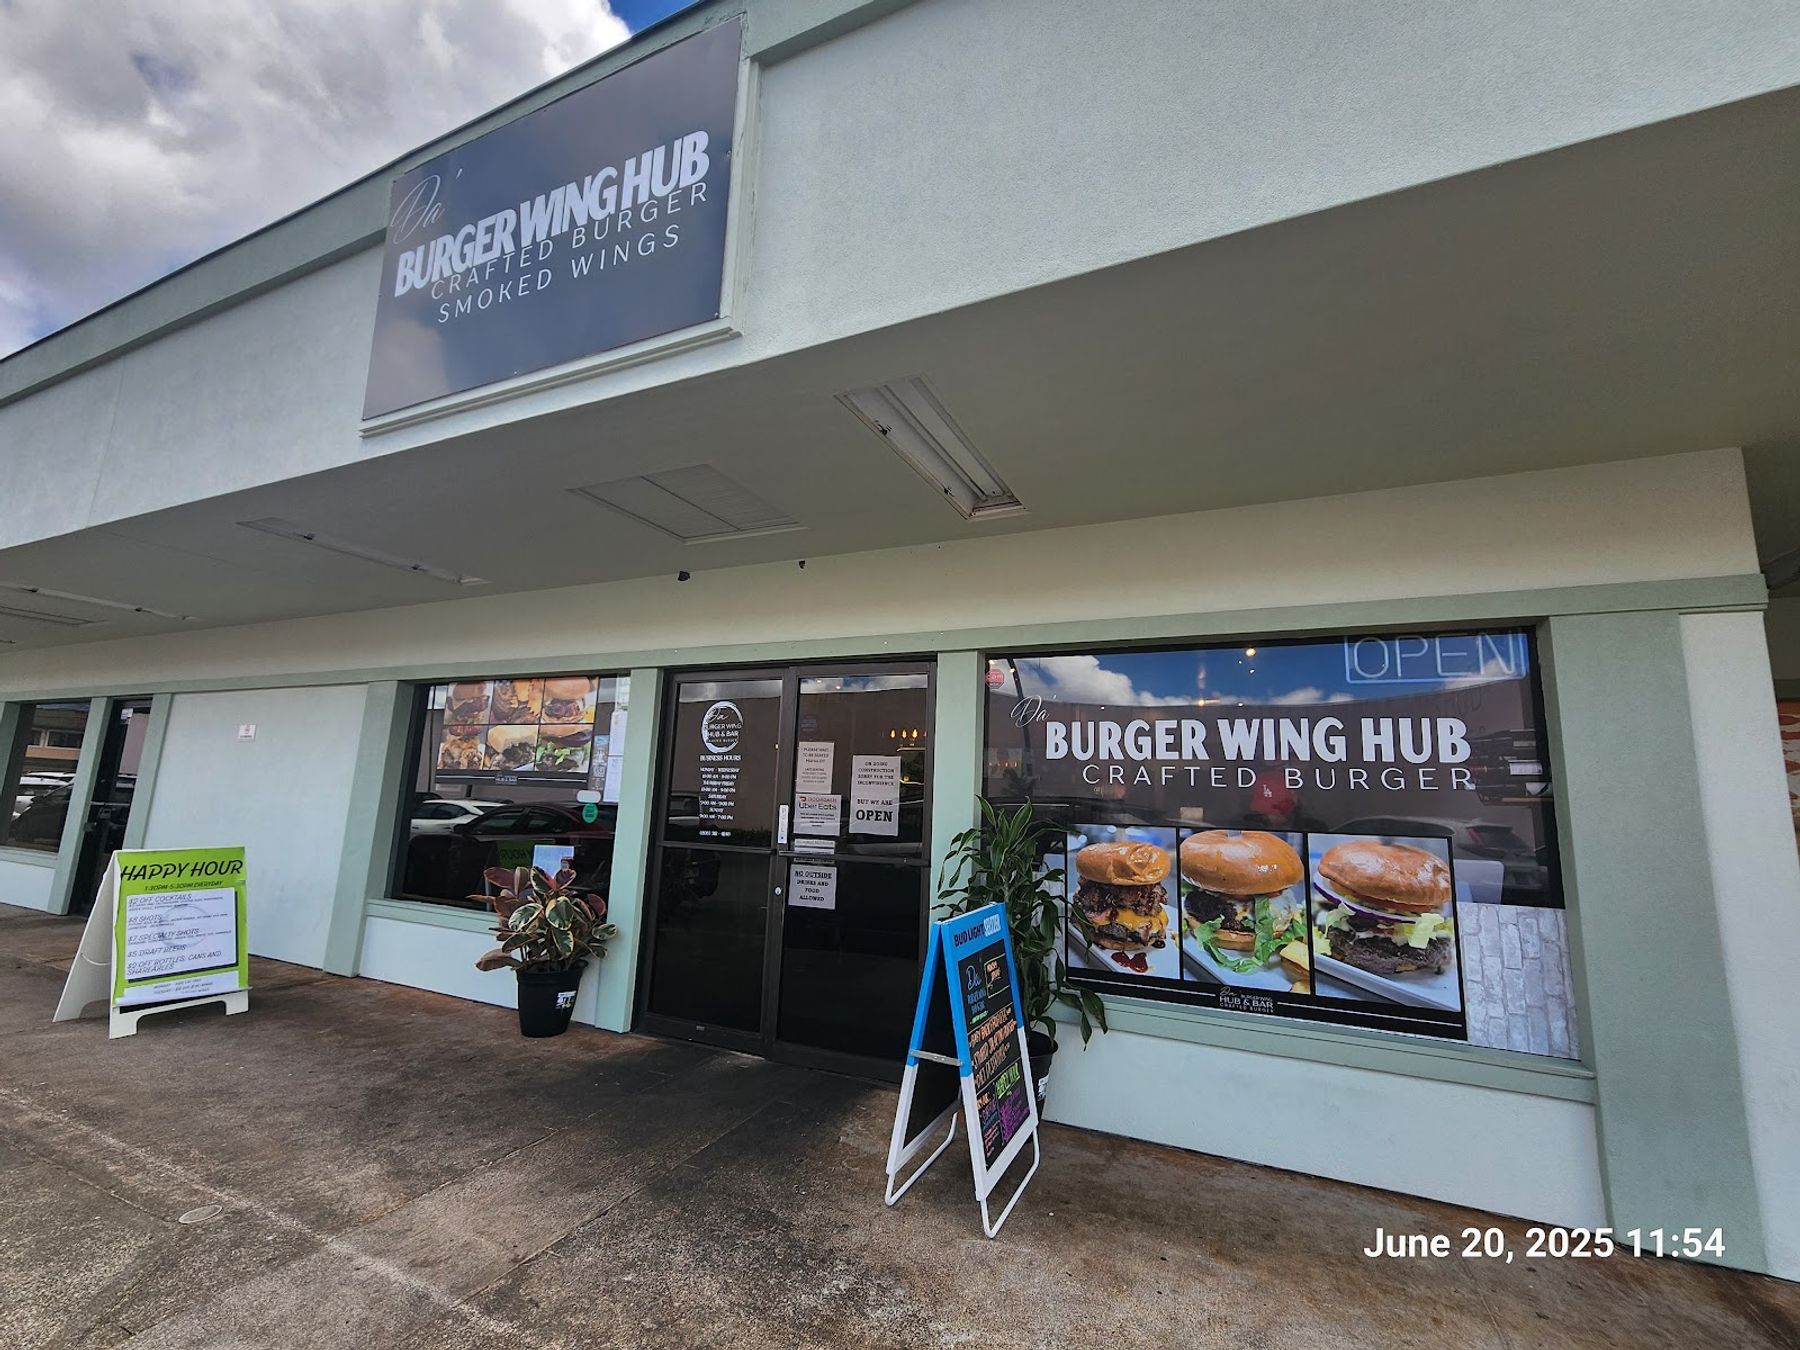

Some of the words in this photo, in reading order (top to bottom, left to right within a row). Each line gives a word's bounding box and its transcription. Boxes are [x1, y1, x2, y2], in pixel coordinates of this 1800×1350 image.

[395, 209, 517, 297] BURGER
[520, 166, 618, 248] WING
[621, 130, 710, 211] HUB
[431, 239, 553, 300] CRAFTED
[572, 182, 707, 249] BURGER
[438, 268, 552, 323] SMOKED
[571, 224, 680, 279] WINGS
[1353, 632, 1516, 678] OPEN
[1046, 719, 1210, 761] BURGER
[1217, 717, 1347, 762] WING
[1361, 717, 1472, 764] HUB
[1082, 764, 1257, 788] CRAFTED
[1285, 767, 1474, 790] BURGER
[856, 809, 893, 822] OPEN
[120, 862, 190, 881] HAPPY
[190, 860, 243, 877] HOUR
[805, 871, 832, 879] OUTSIDE
[194, 880, 223, 888] EVERYDAY
[155, 894, 192, 902] COCKTAILS
[139, 914, 162, 922] SHOTS
[176, 928, 201, 937] SHOTS
[953, 932, 968, 948] BUD
[967, 923, 985, 941] LIGHT
[139, 948, 163, 957] DRAFT
[188, 952, 207, 961] CANS
[1220, 996, 1241, 1005] HUB
[1252, 1000, 1274, 1009] BAR
